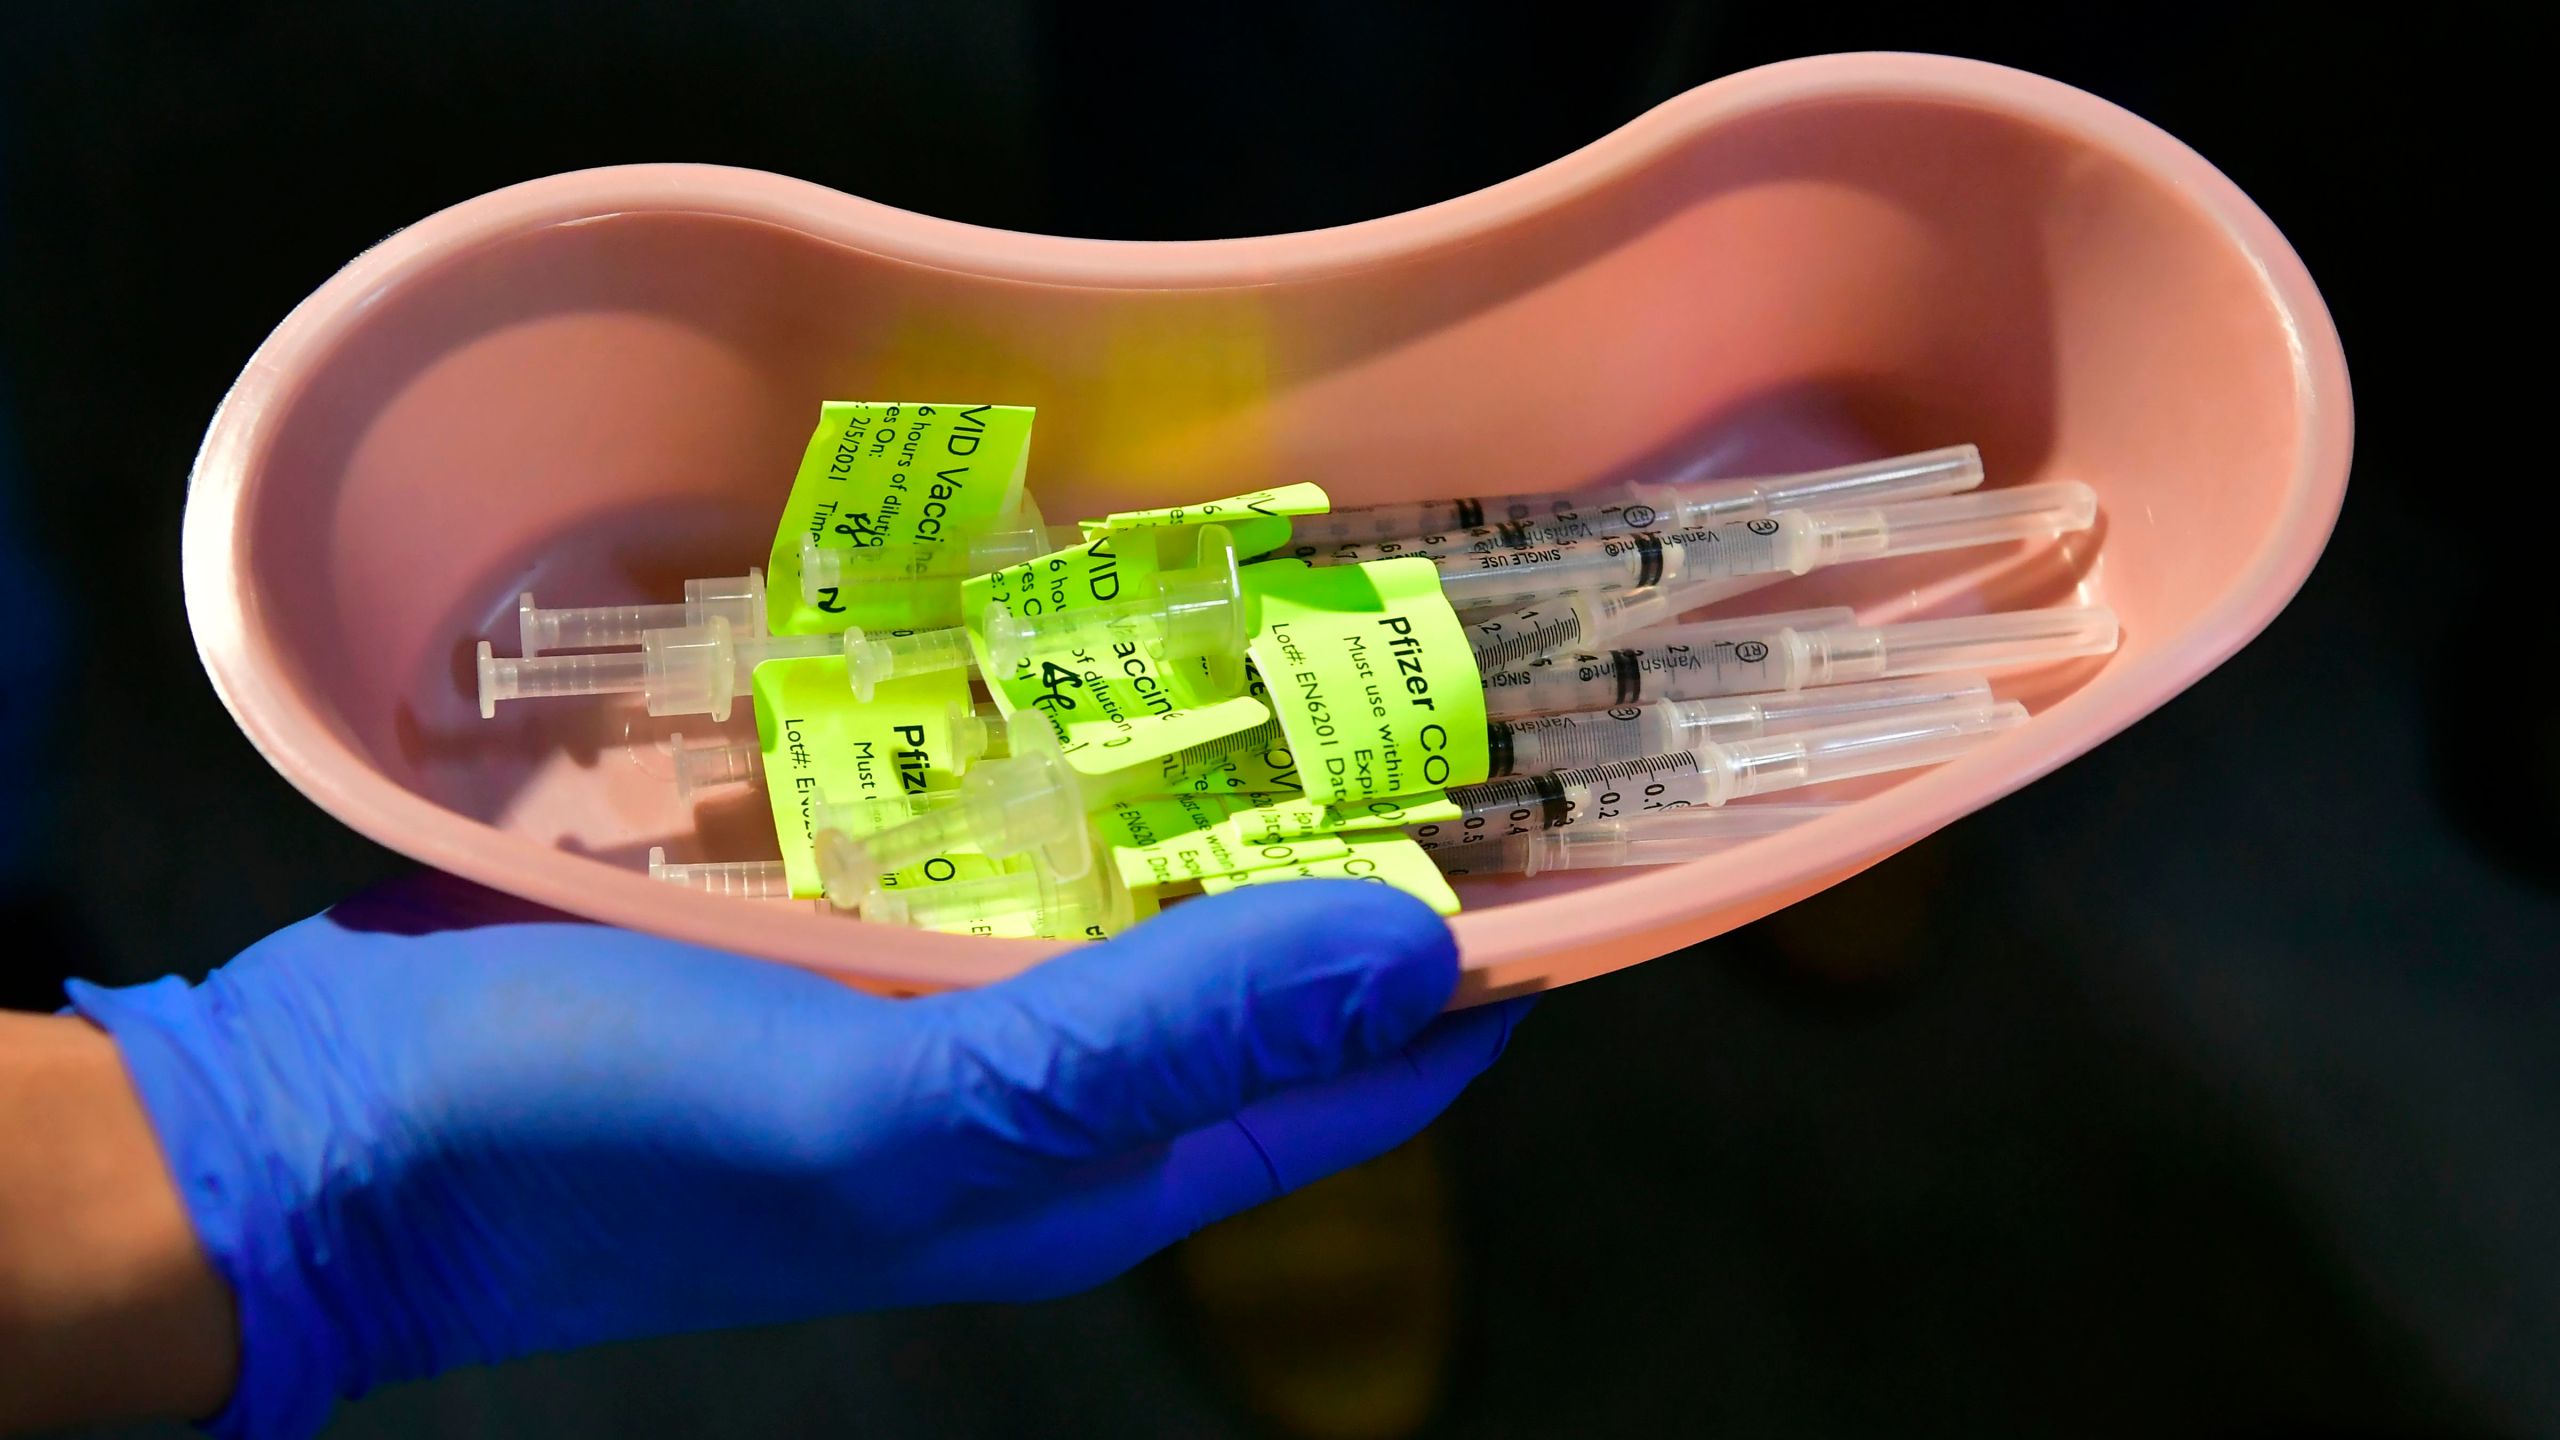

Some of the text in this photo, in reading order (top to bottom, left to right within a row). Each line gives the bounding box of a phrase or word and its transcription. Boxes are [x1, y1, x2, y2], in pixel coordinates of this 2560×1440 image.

[918, 405, 936, 416] 6
[828, 416, 871, 481] 2/5/2021
[868, 428, 895, 458] On:
[897, 421, 931, 468] hours
[890, 473, 907, 491] of
[1481, 549, 1561, 570] SINGLE USE
[1050, 558, 1068, 572] 6
[1084, 671, 1132, 732] dilution
[1378, 616, 1435, 711] Pfizer
[1272, 623, 1306, 667] Lot#:
[1296, 672, 1338, 746] EN6201
[1343, 635, 1402, 792] Must use within
[785, 719, 811, 770] Lot#:
[853, 742, 877, 791] Must
[1598, 792, 1620, 820] 0.2
[1644, 783, 1665, 811] 0.1
[1192, 813, 1211, 831] use
[1464, 817, 1485, 843] 0.5
[1507, 809, 1531, 836] 0.4
